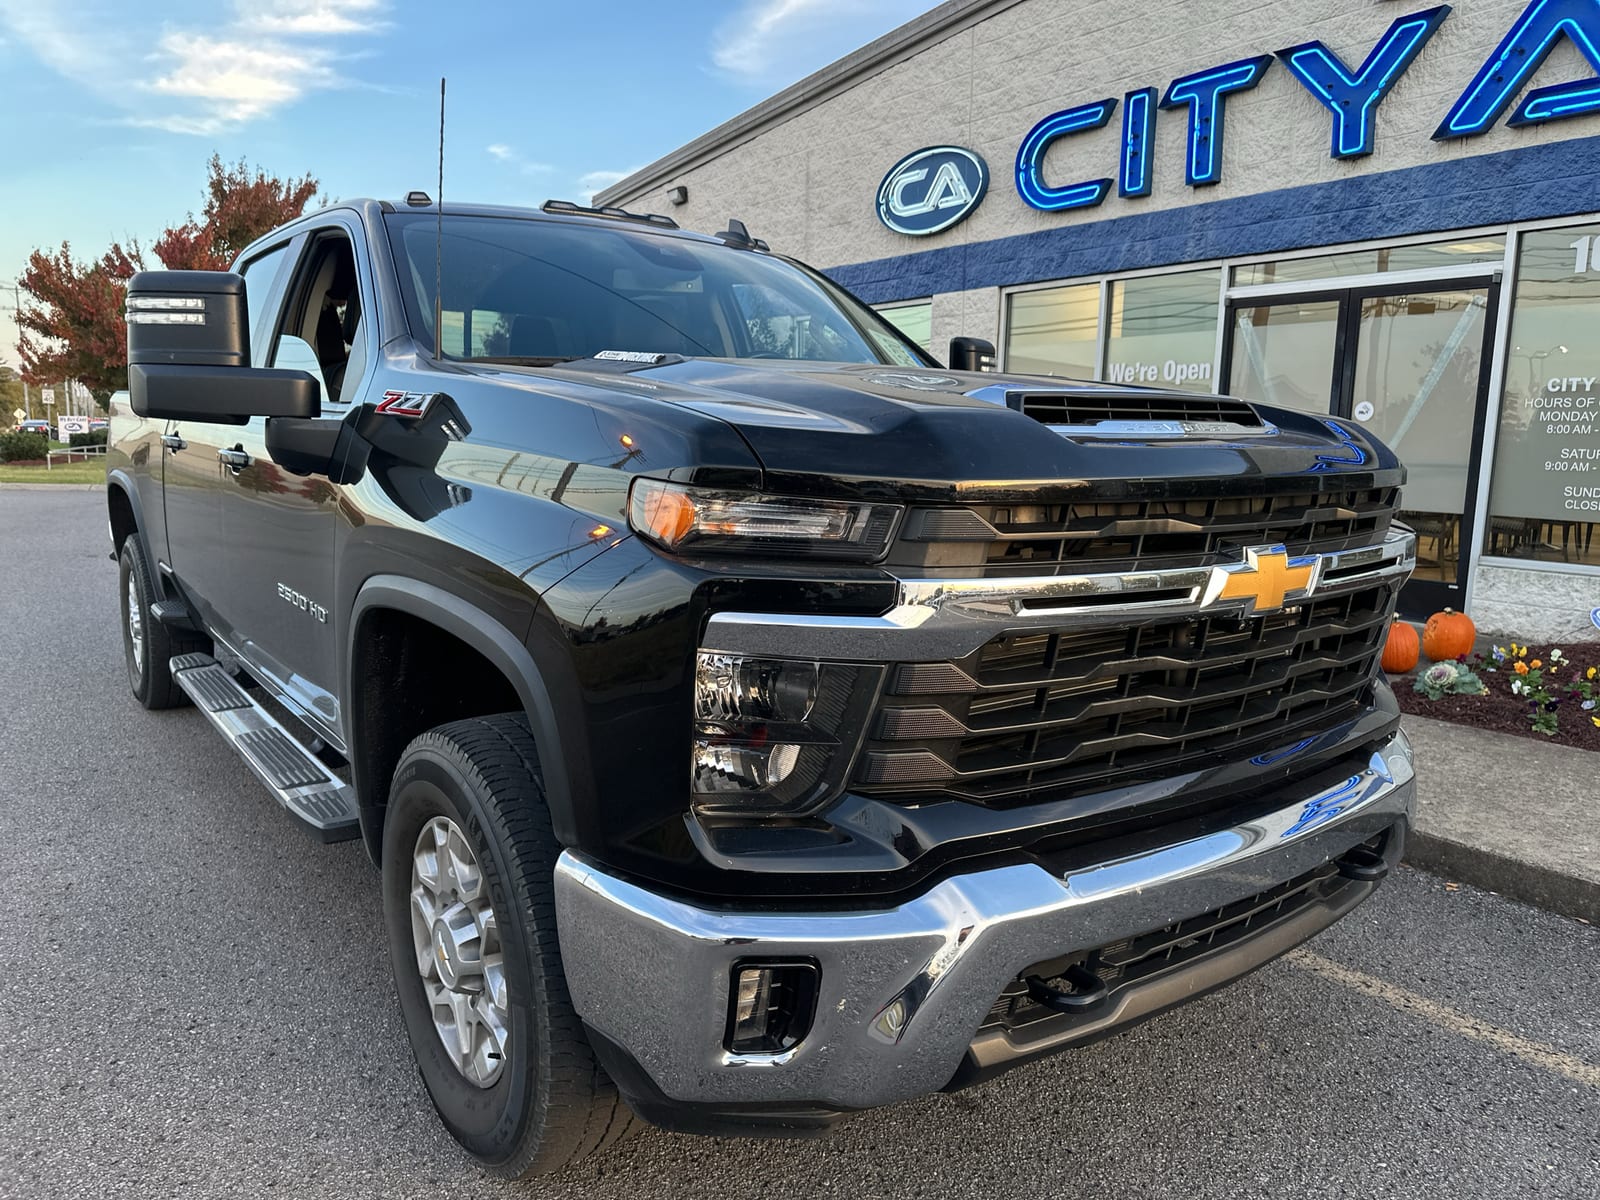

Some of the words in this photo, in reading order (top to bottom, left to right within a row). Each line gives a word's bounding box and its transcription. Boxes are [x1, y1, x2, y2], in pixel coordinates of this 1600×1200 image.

[1015, 4, 1453, 212] CITY
[889, 161, 972, 217] CA
[1109, 362, 1158, 383] We're
[1163, 360, 1211, 385] Open
[1547, 377, 1596, 392] CITY
[374, 388, 440, 418] Z71
[1524, 397, 1572, 409] HOURS
[1575, 397, 1596, 408] OF
[1540, 411, 1599, 422] MONDAY
[1546, 424, 1570, 434] 8:00
[1571, 424, 1591, 434] AM
[1544, 461, 1568, 471] 9:00
[1570, 462, 1590, 472] AM
[1564, 499, 1600, 511] CLOS
